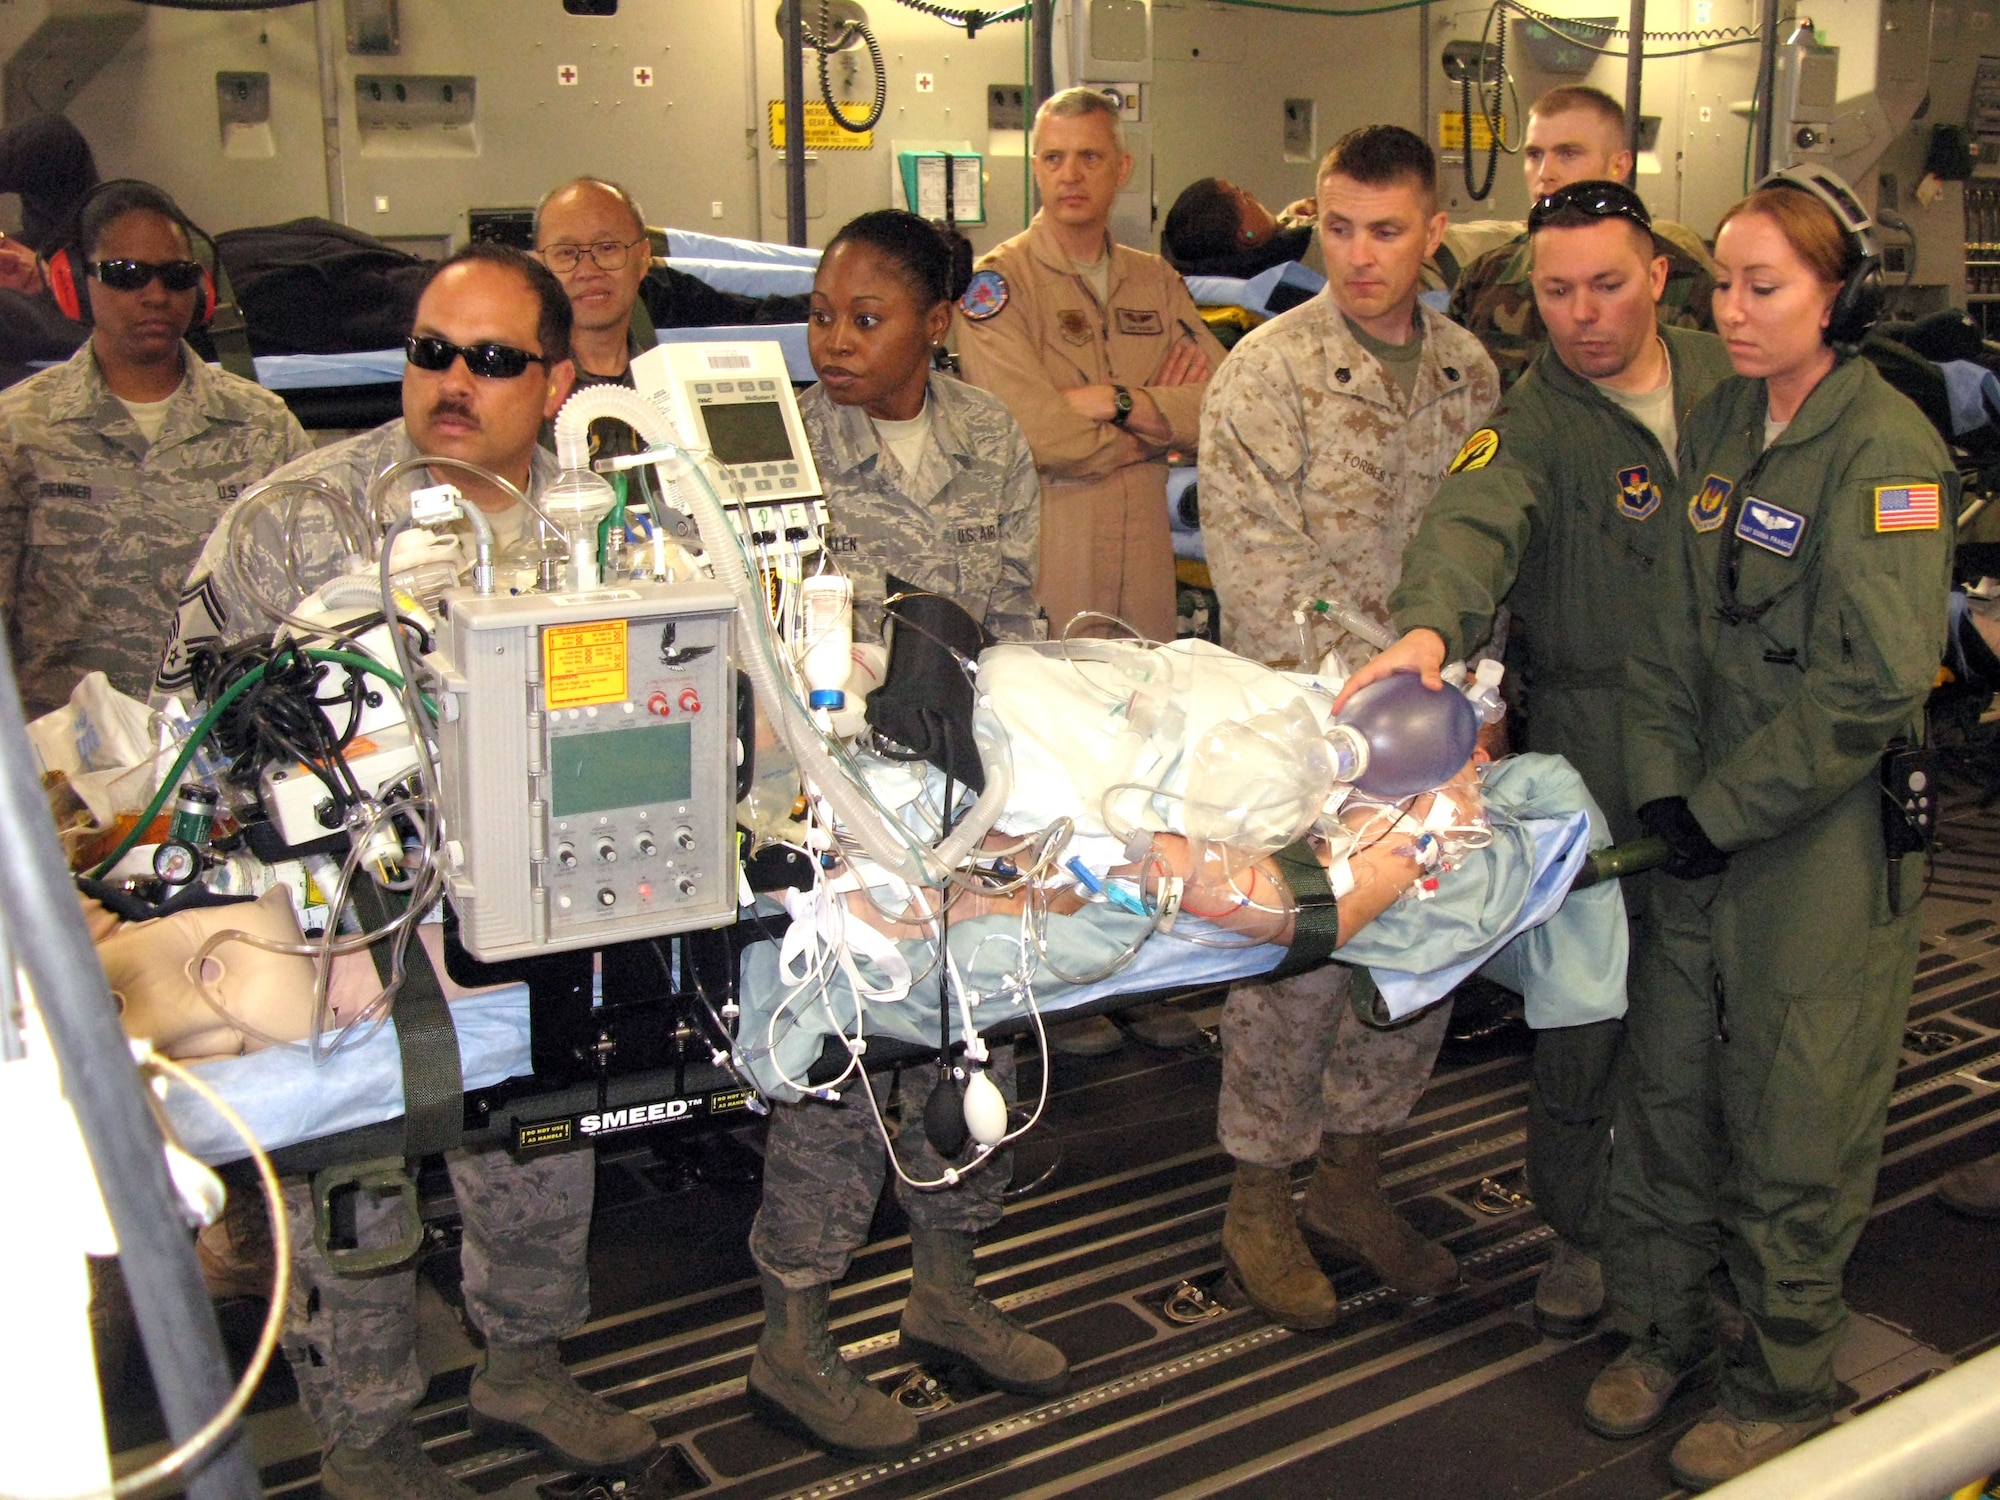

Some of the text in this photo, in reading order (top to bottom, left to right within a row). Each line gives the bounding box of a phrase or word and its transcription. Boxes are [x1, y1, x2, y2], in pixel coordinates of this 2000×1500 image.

[1343, 452, 1386, 482] FORBES
[537, 1126, 551, 1134] NOT
[527, 1132, 563, 1144] AS HANDLE
